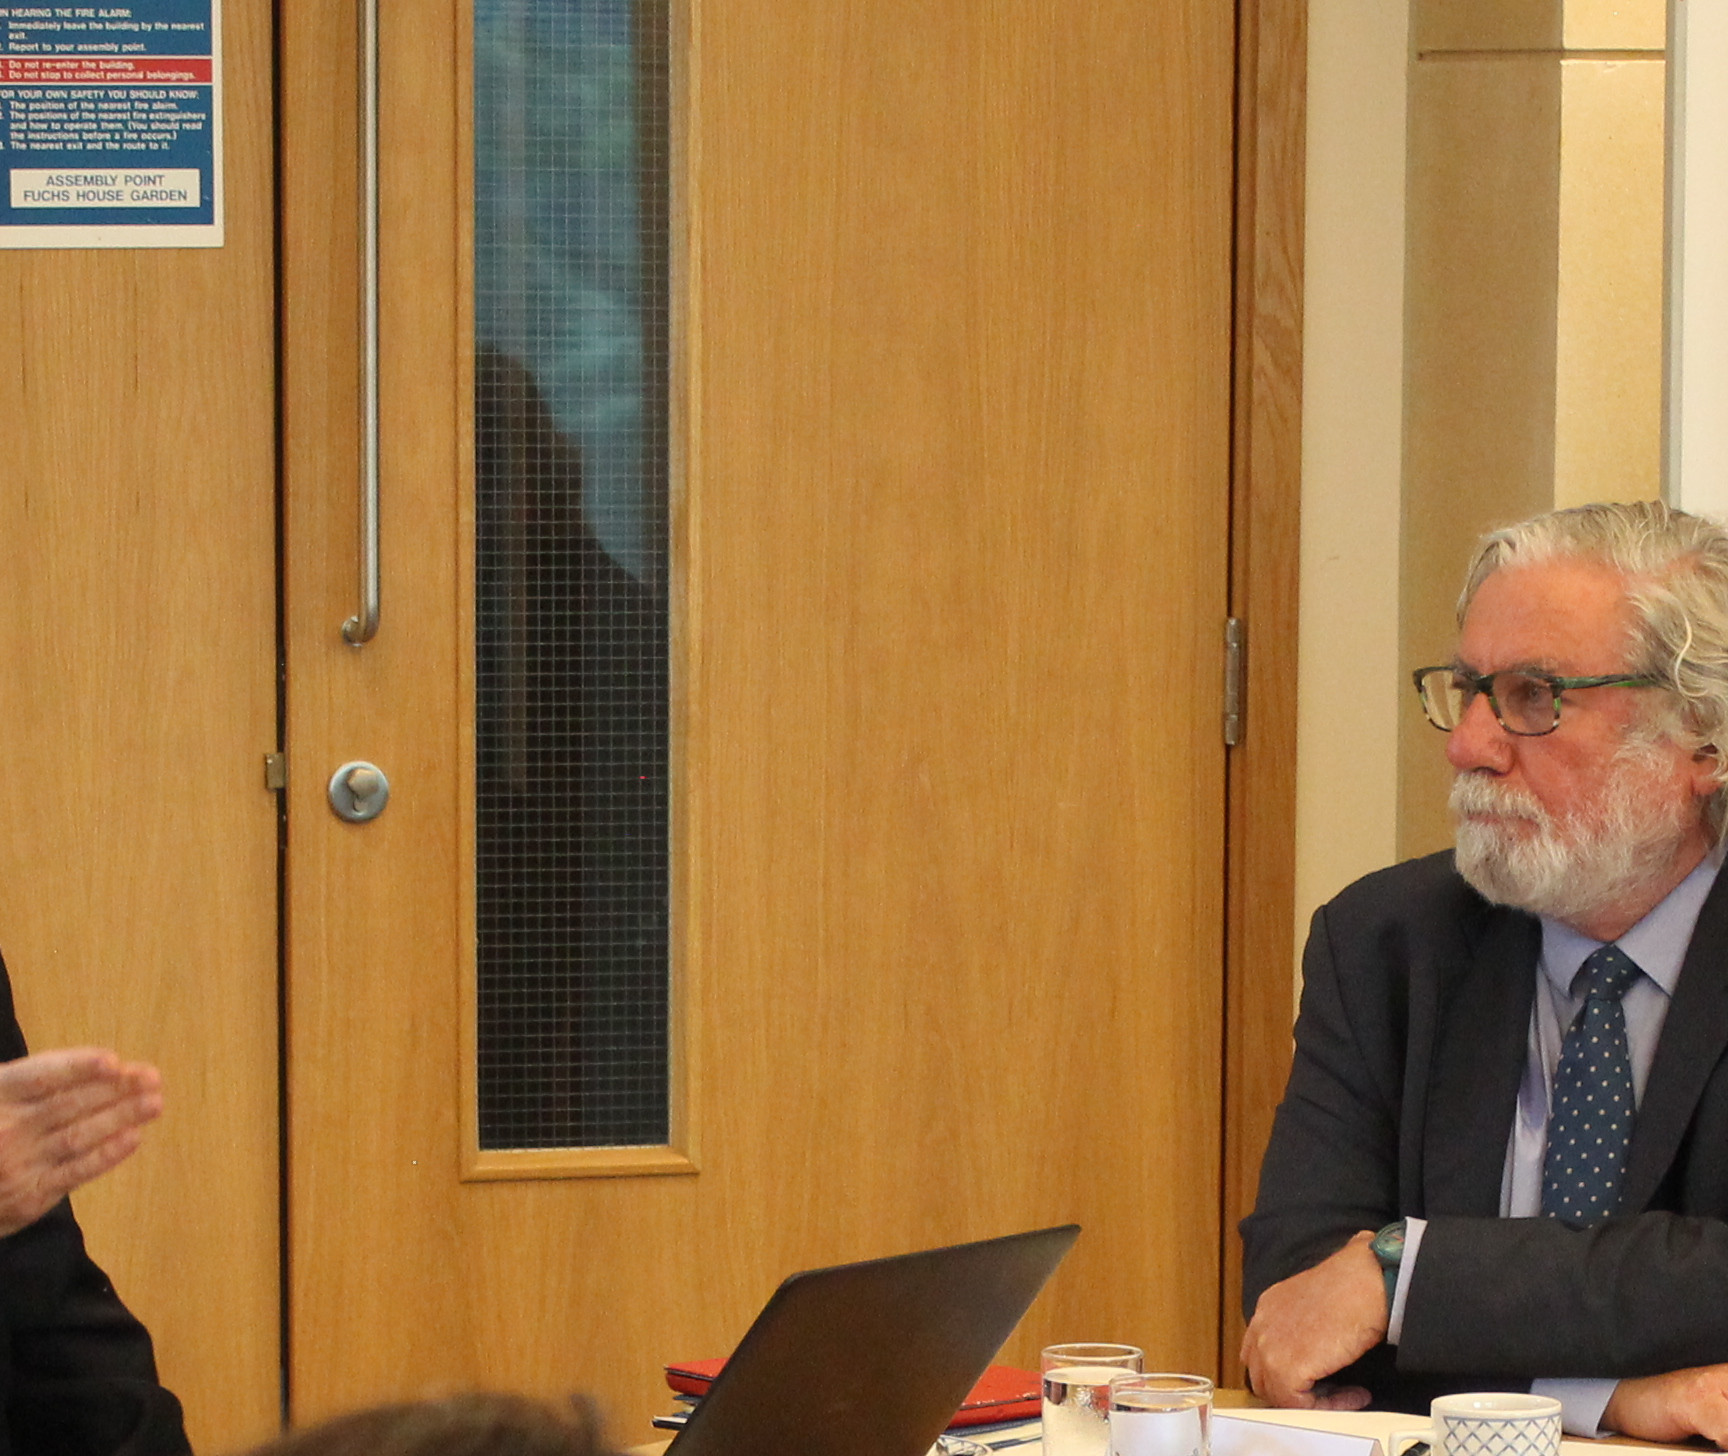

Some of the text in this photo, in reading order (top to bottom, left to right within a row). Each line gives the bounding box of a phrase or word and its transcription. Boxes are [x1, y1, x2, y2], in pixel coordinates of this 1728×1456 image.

[46, 175, 164, 186] ASSEMBLY POINT
[24, 190, 187, 202] FUCHS HOUSE GARDEN
